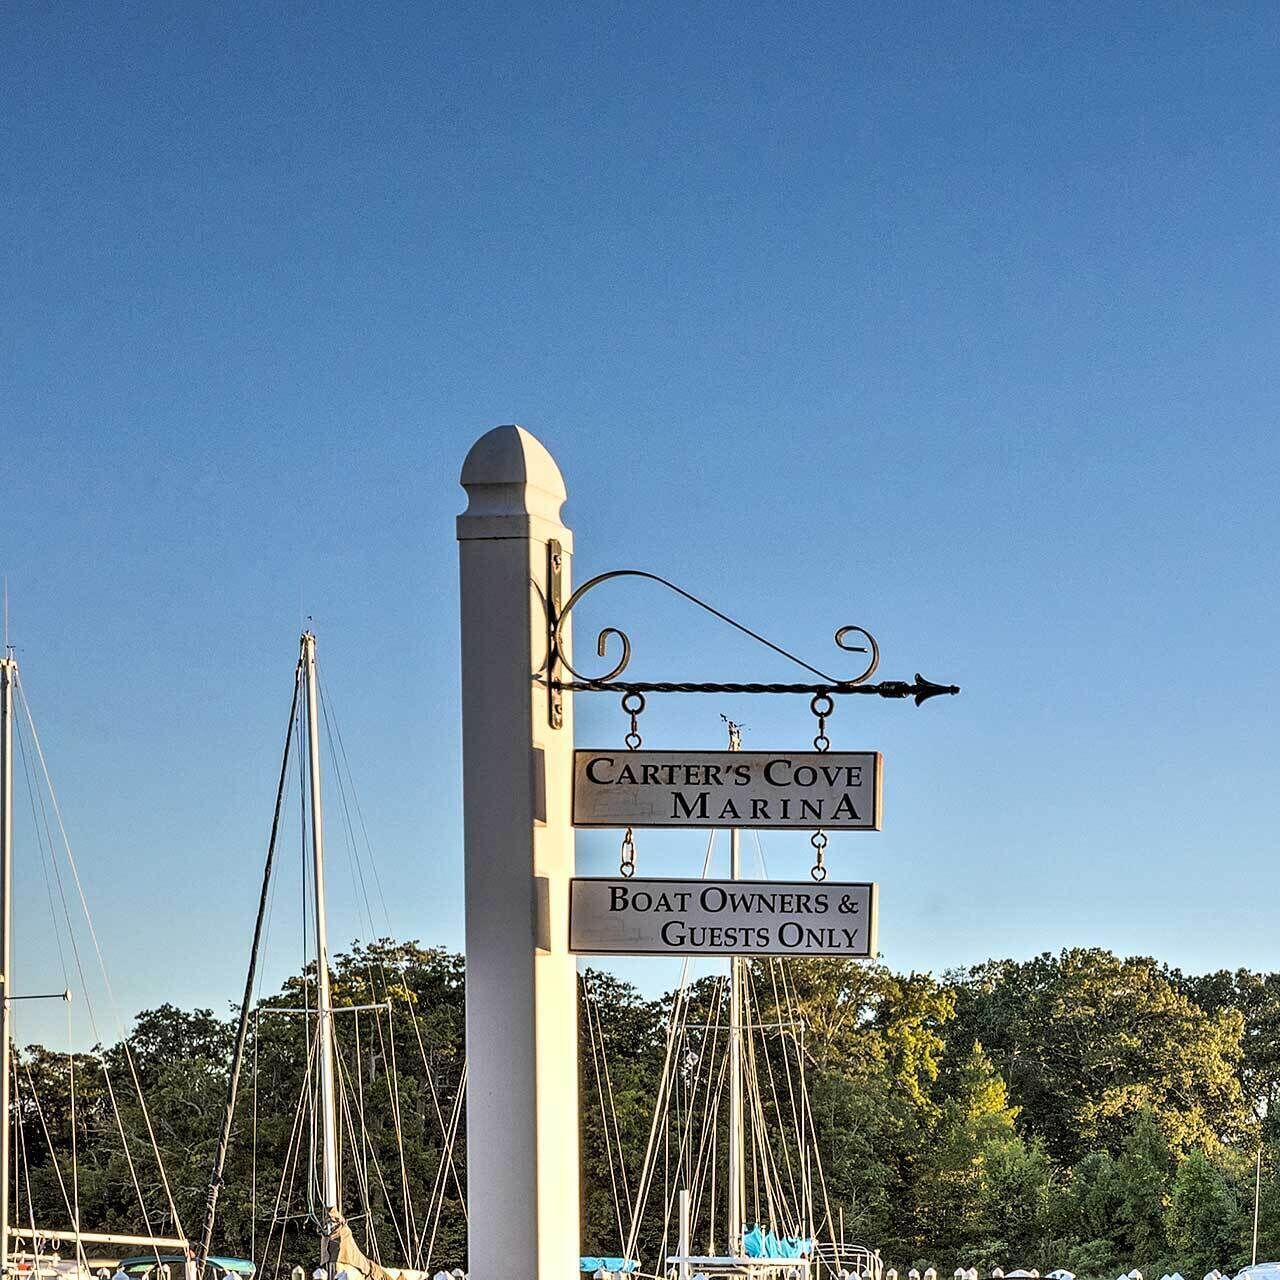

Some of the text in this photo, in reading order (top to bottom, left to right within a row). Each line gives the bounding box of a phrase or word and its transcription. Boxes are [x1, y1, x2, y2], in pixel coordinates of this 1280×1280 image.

[585, 757, 862, 788] CARTER'S COVE
[669, 791, 861, 821] MARINA
[608, 886, 859, 915] BOAT OWNERS &
[661, 920, 859, 949] GUESTS ONLY
